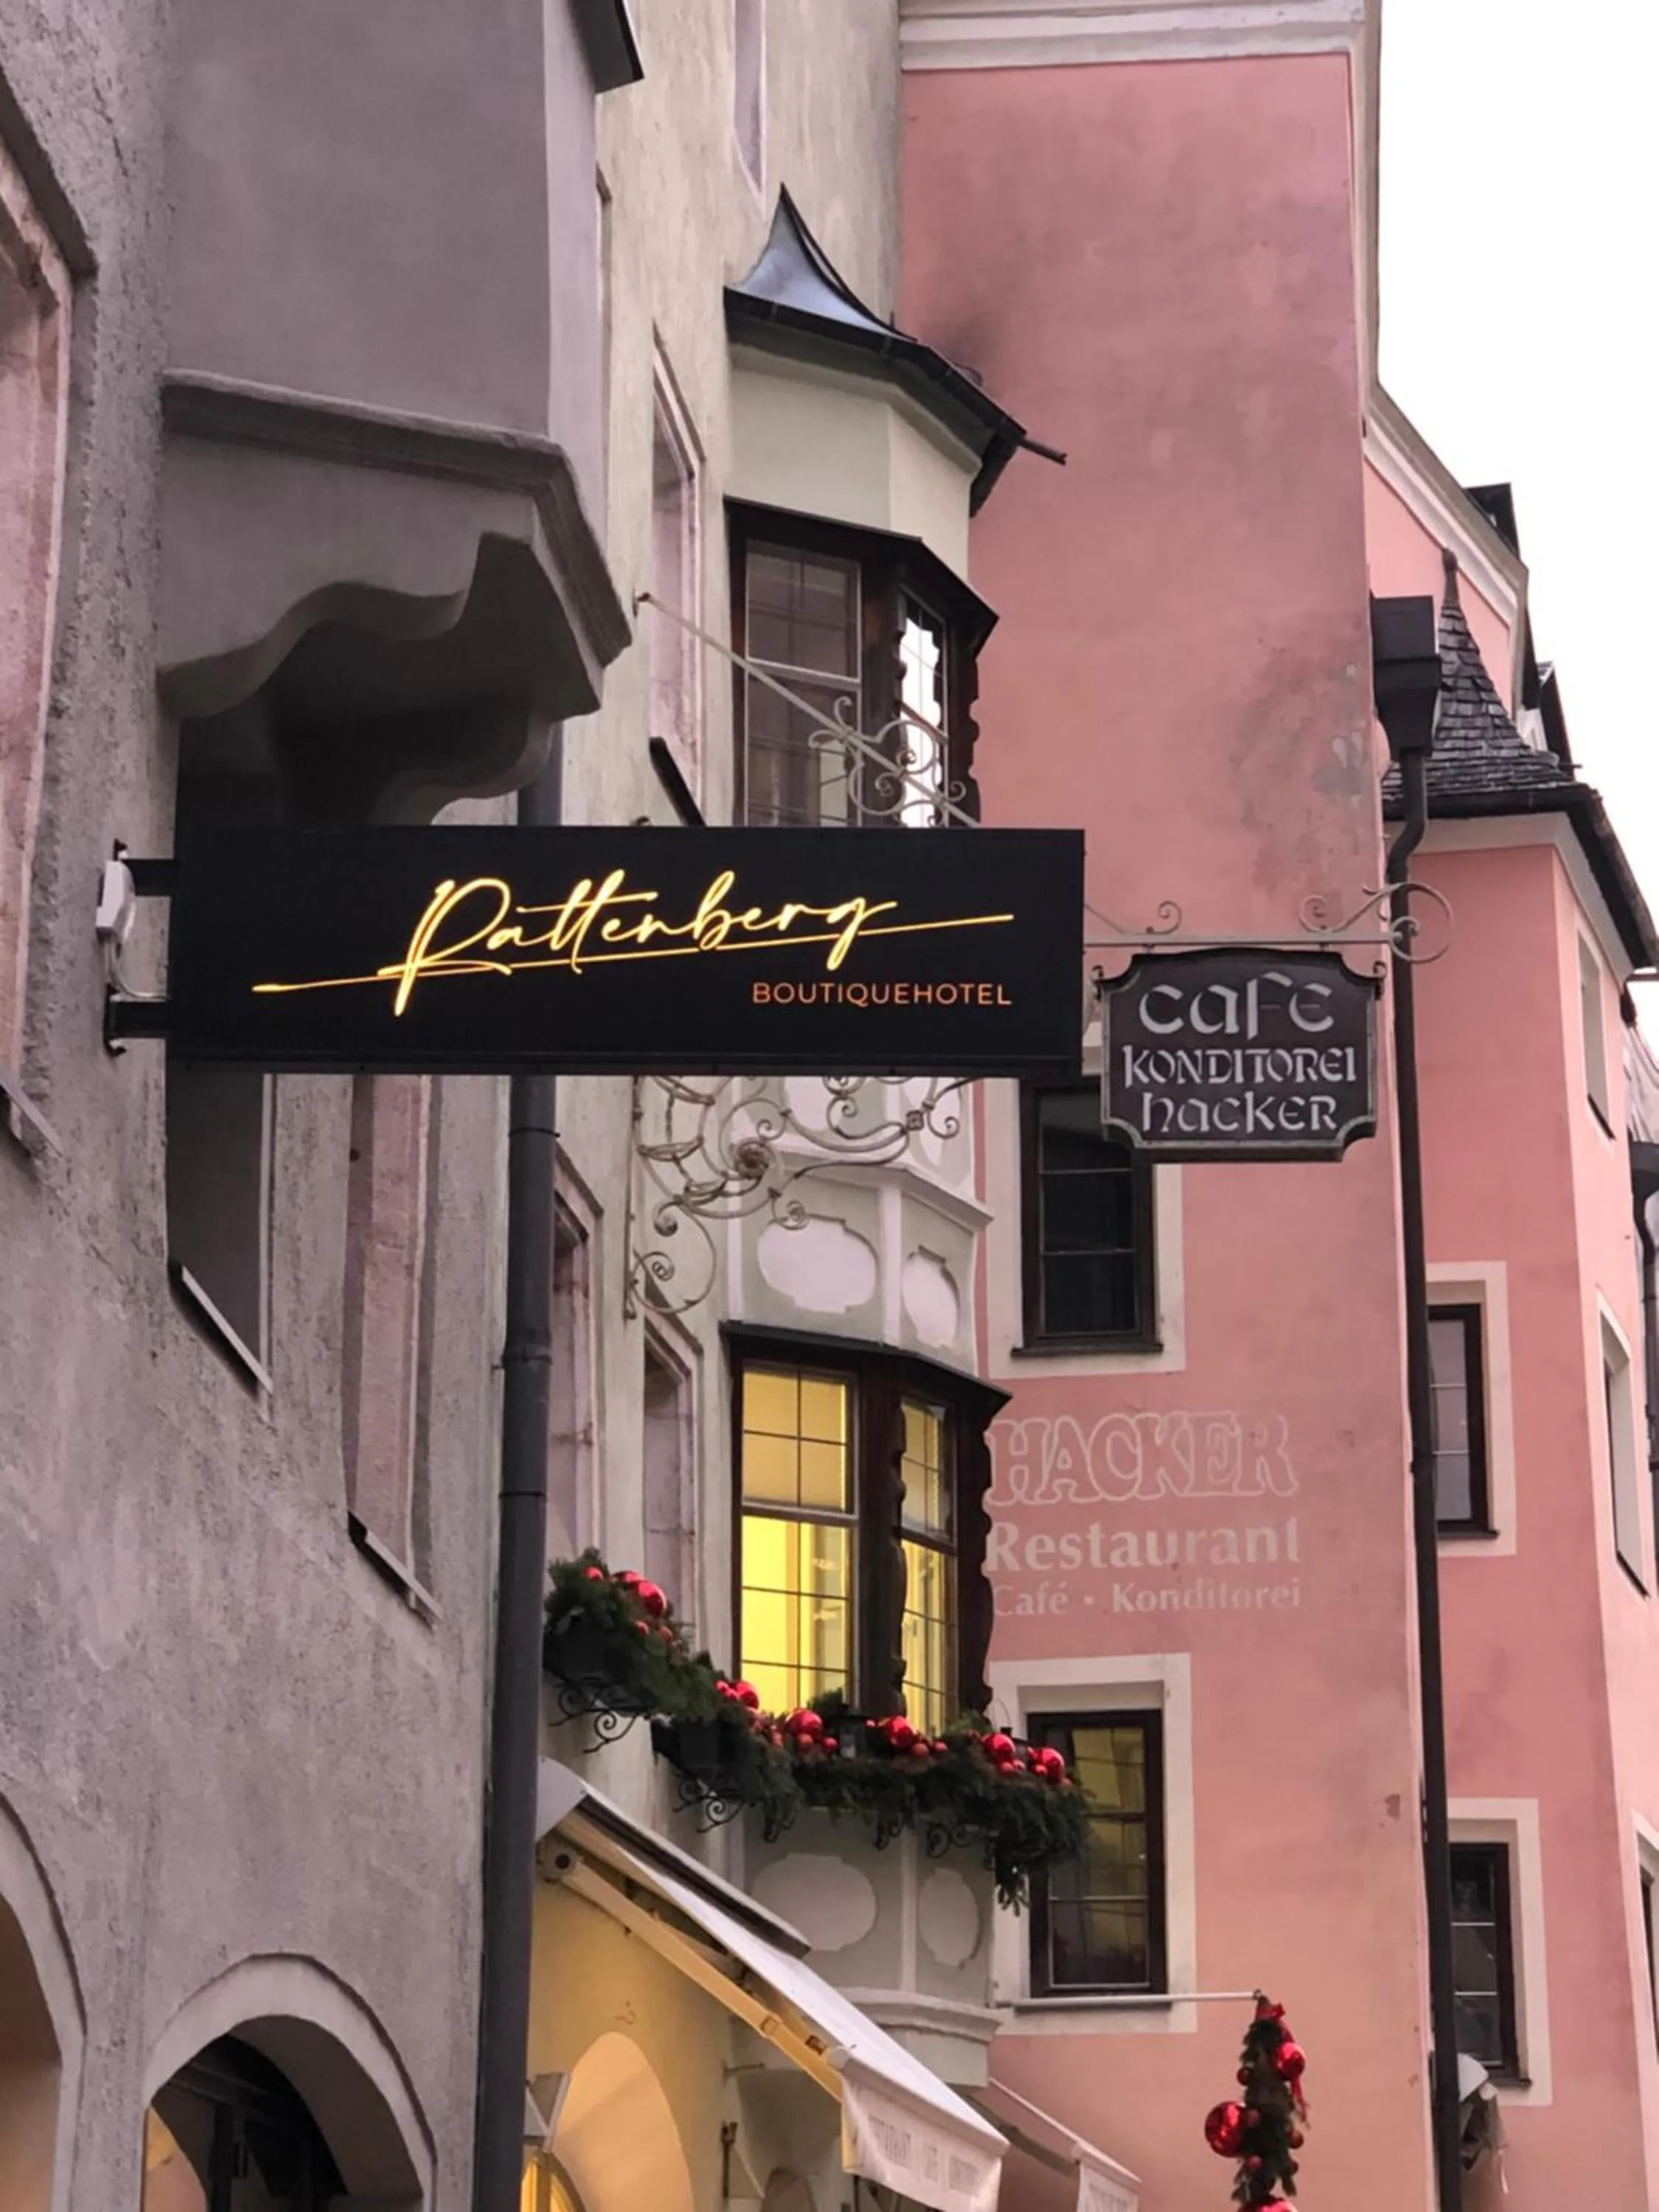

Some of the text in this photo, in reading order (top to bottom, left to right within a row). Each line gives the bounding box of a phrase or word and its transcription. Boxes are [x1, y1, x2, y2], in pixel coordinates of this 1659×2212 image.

[752, 982, 1012, 1008] BOUTIQUEHOTEL
[1122, 1044, 1357, 1088] KONDITOREI
[983, 1410, 1300, 1506] HACKER
[985, 1517, 1301, 1572] Restaurant
[993, 1577, 1301, 1616] Café Konditorei
